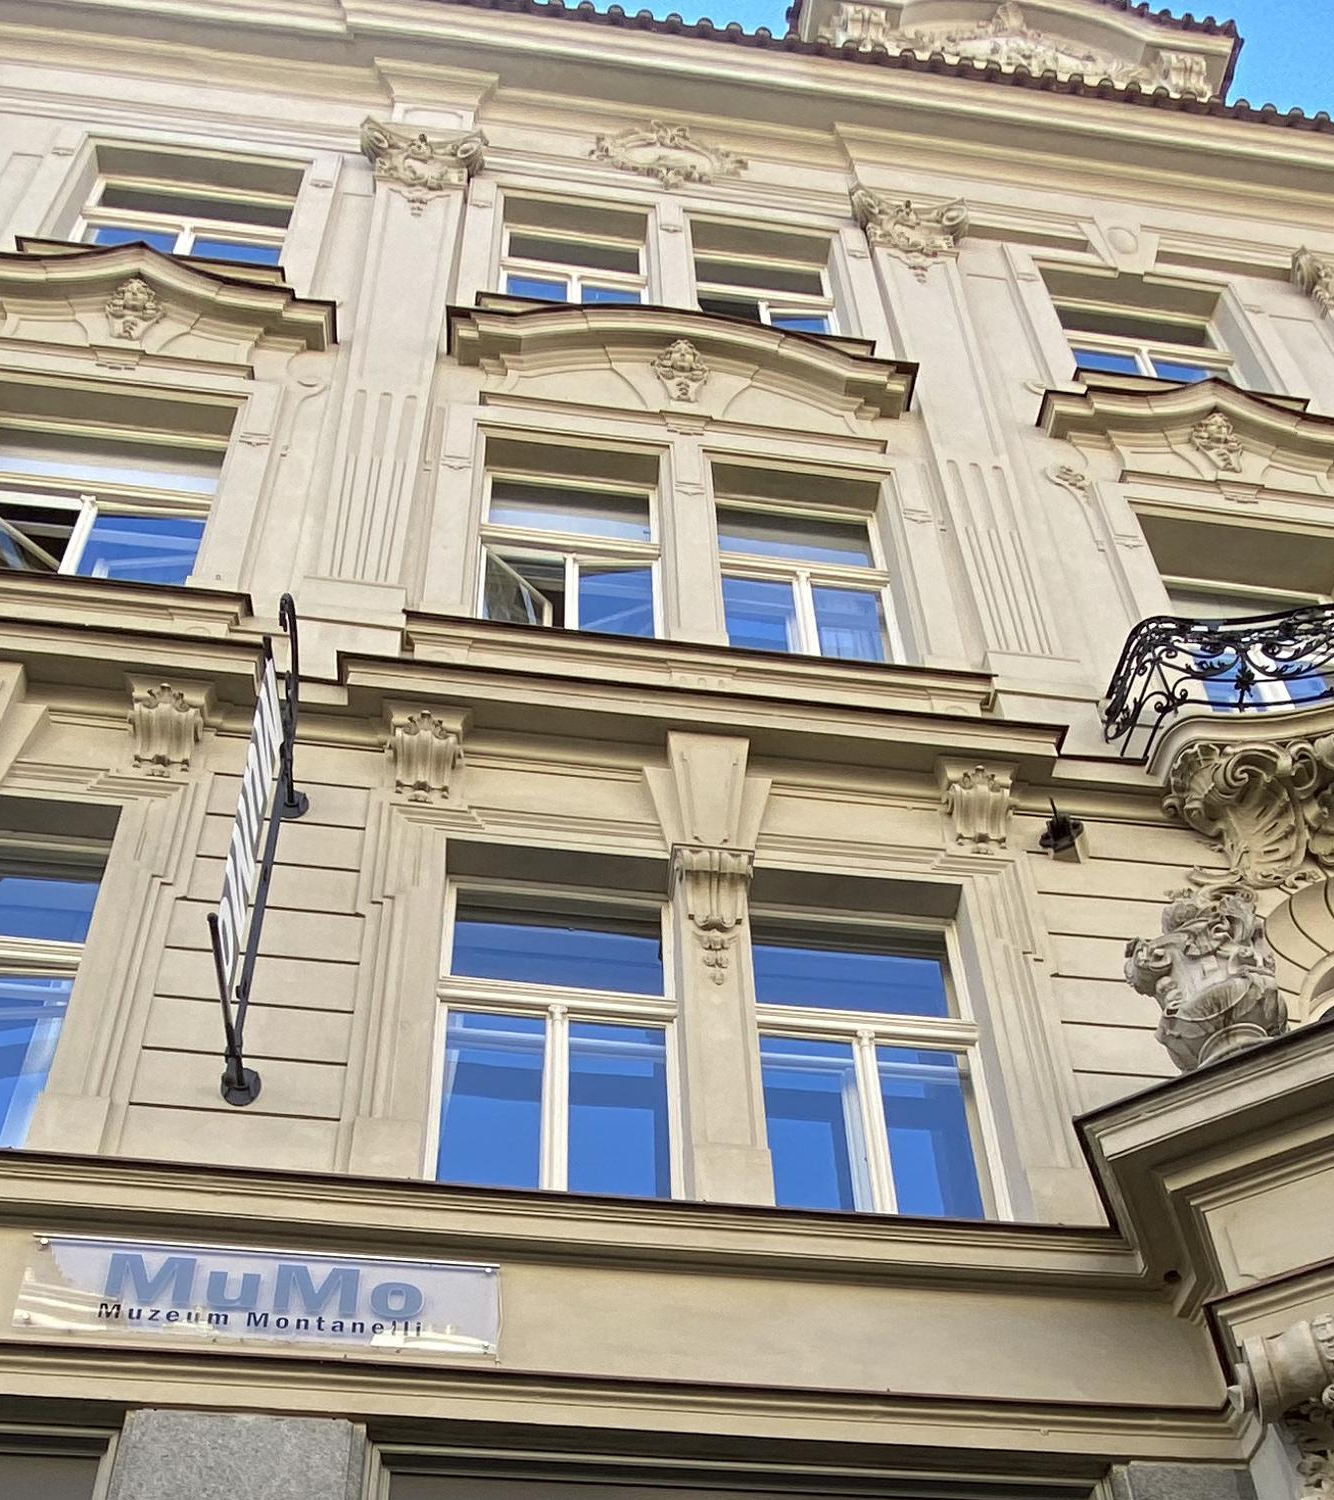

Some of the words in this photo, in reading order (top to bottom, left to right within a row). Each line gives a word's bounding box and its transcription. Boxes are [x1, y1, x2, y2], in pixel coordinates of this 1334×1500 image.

[104, 1252, 425, 1320] MuMo
[98, 1303, 229, 1327] Muzeum
[246, 1311, 422, 1336] Montanelli
